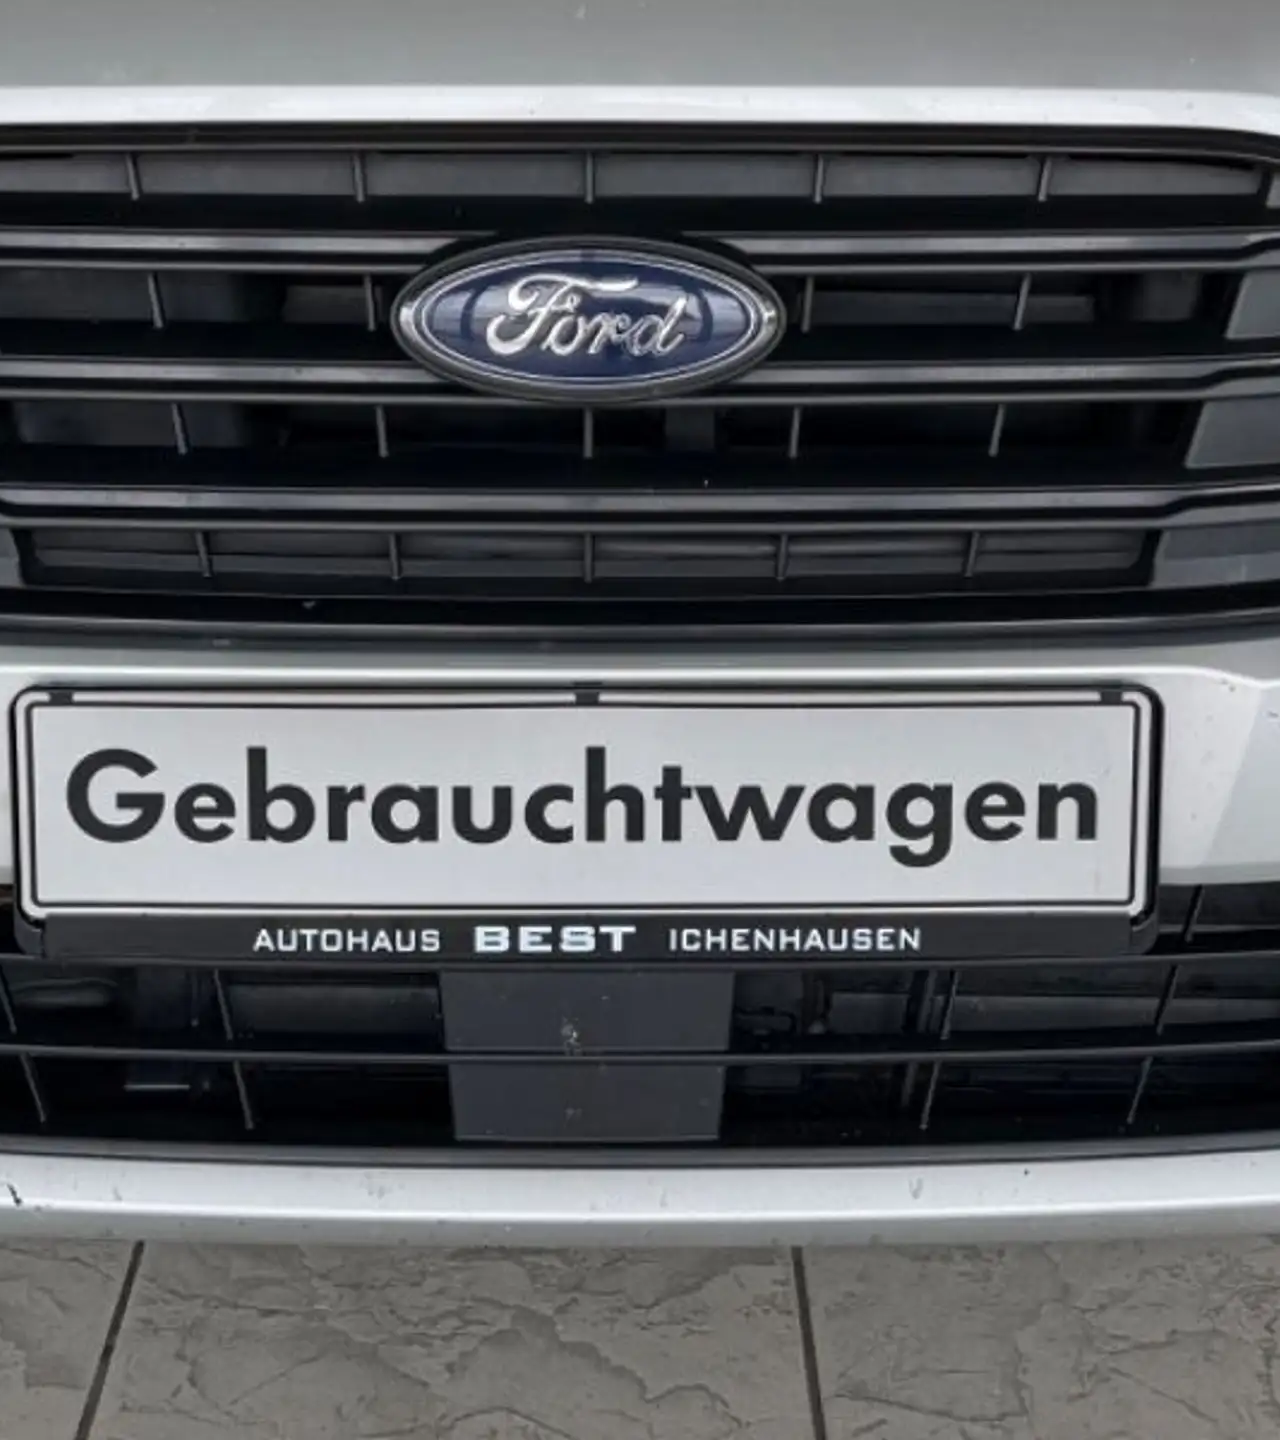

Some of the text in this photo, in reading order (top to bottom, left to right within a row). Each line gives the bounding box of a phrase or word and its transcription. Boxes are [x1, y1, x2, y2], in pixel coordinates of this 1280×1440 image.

[486, 272, 689, 358] Ford
[65, 746, 1099, 868] Gebrauchtwagen
[252, 926, 921, 953] AUTOHAUS BEST ICHENHAUSEN
